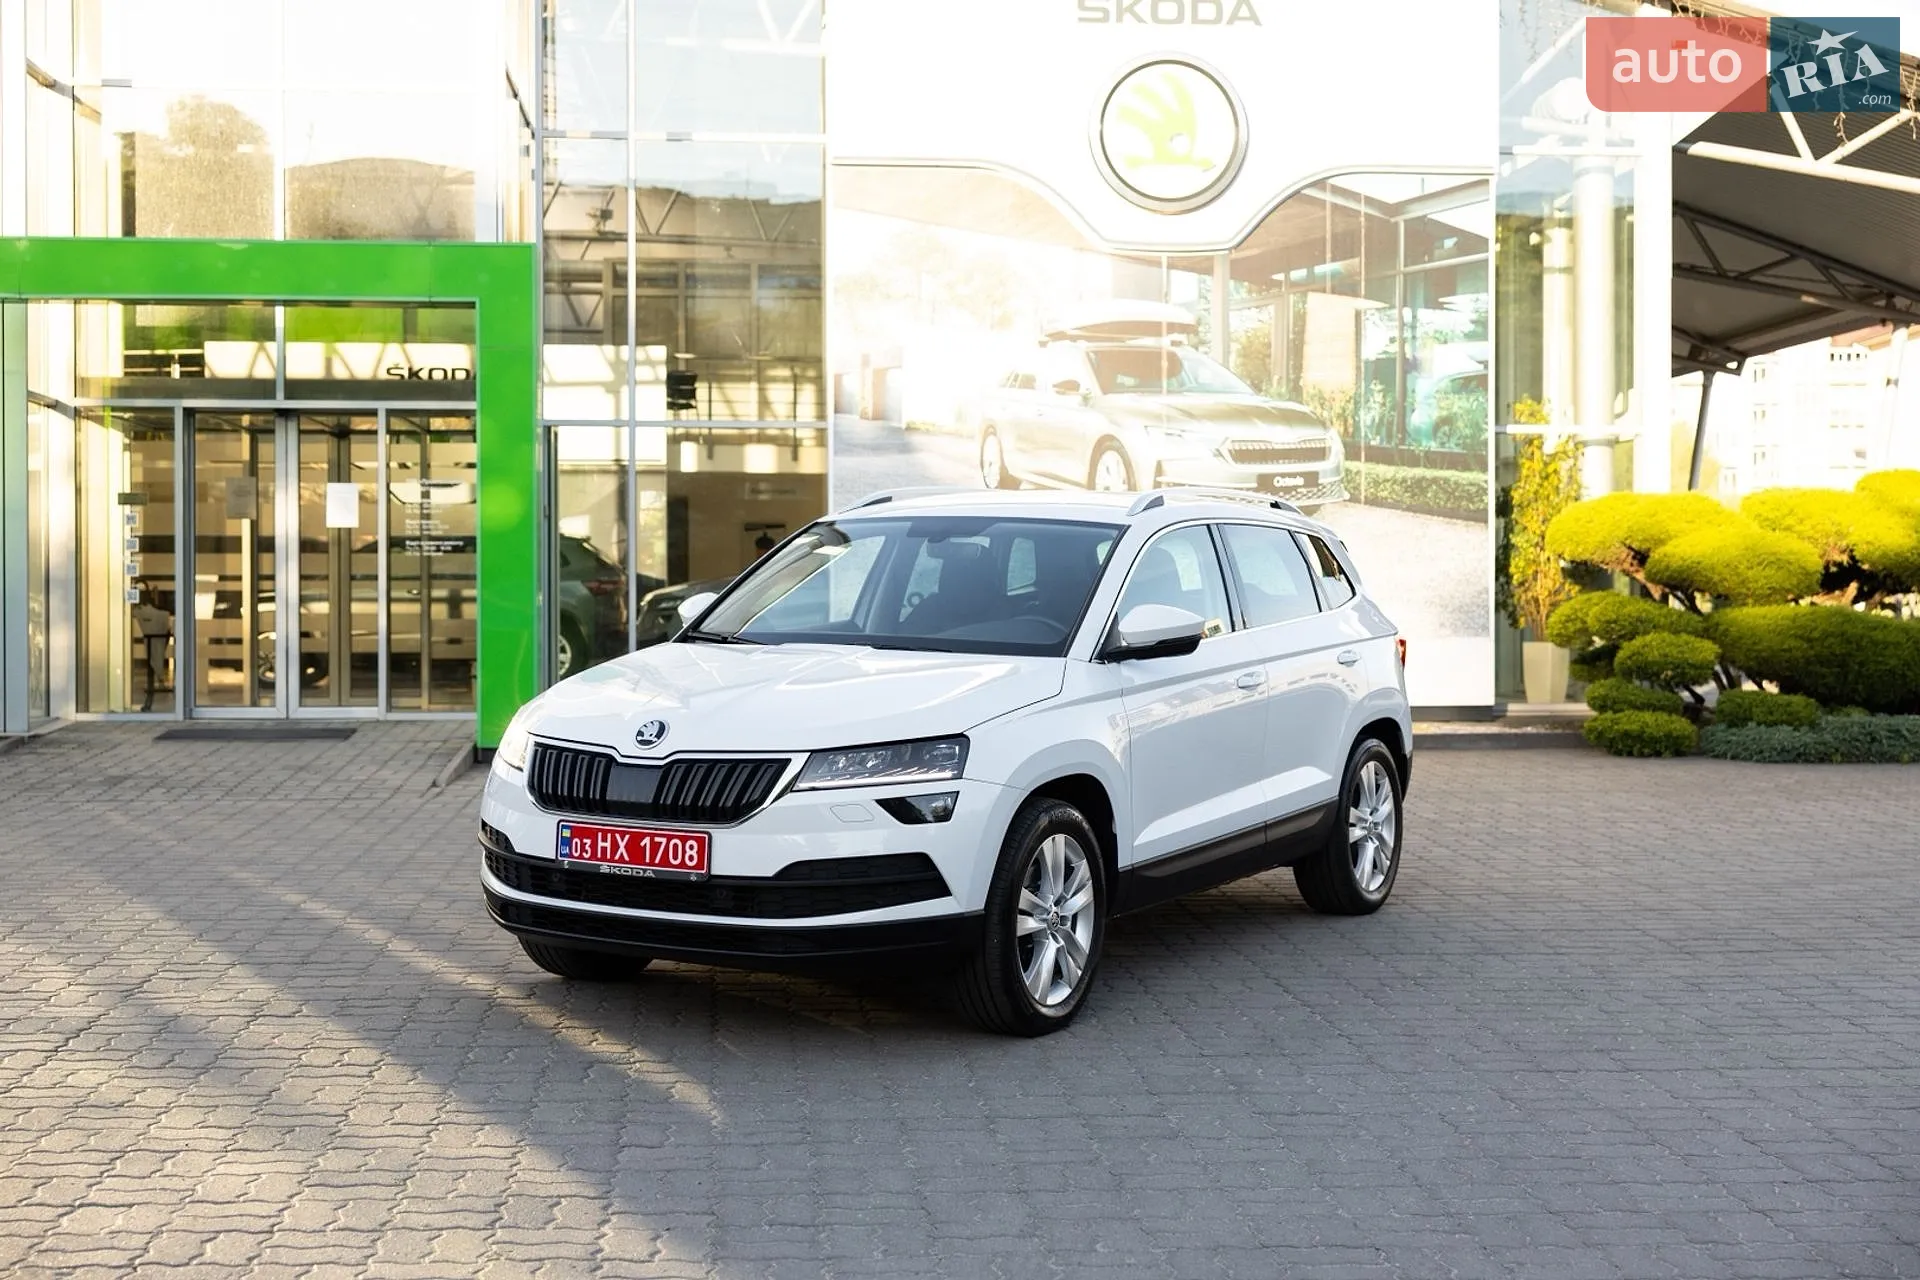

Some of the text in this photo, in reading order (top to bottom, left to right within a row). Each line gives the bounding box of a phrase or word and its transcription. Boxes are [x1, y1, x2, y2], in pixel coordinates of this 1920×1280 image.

[386, 363, 476, 381] ŠKOD
[571, 831, 699, 867] 03 HX 1708
